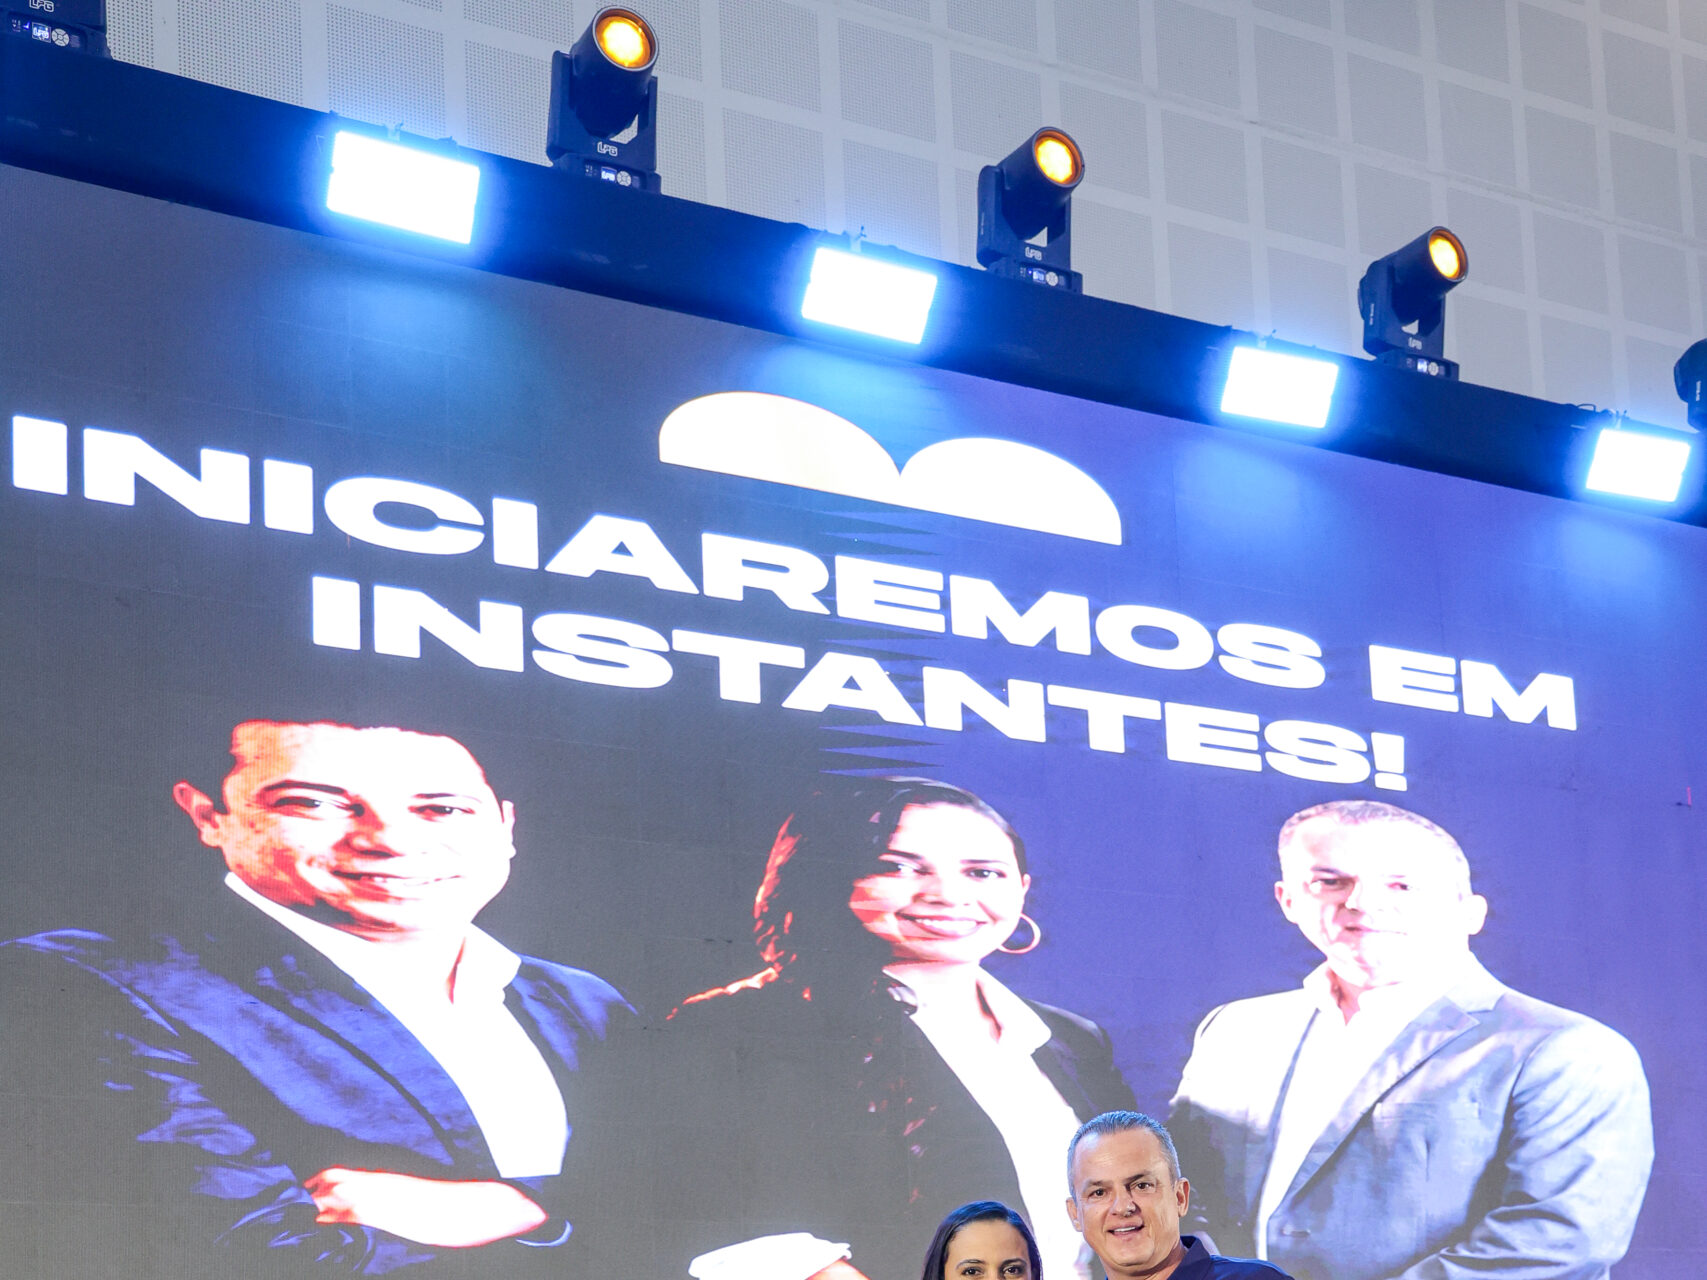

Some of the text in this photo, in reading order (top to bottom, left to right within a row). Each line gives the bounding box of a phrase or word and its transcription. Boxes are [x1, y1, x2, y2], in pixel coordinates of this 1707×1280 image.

[29, 0, 54, 13] LPG
[597, 141, 618, 157] LPG
[11, 415, 1578, 731] INICIAREMOS EM
[311, 576, 1408, 792] INSTANTES!
